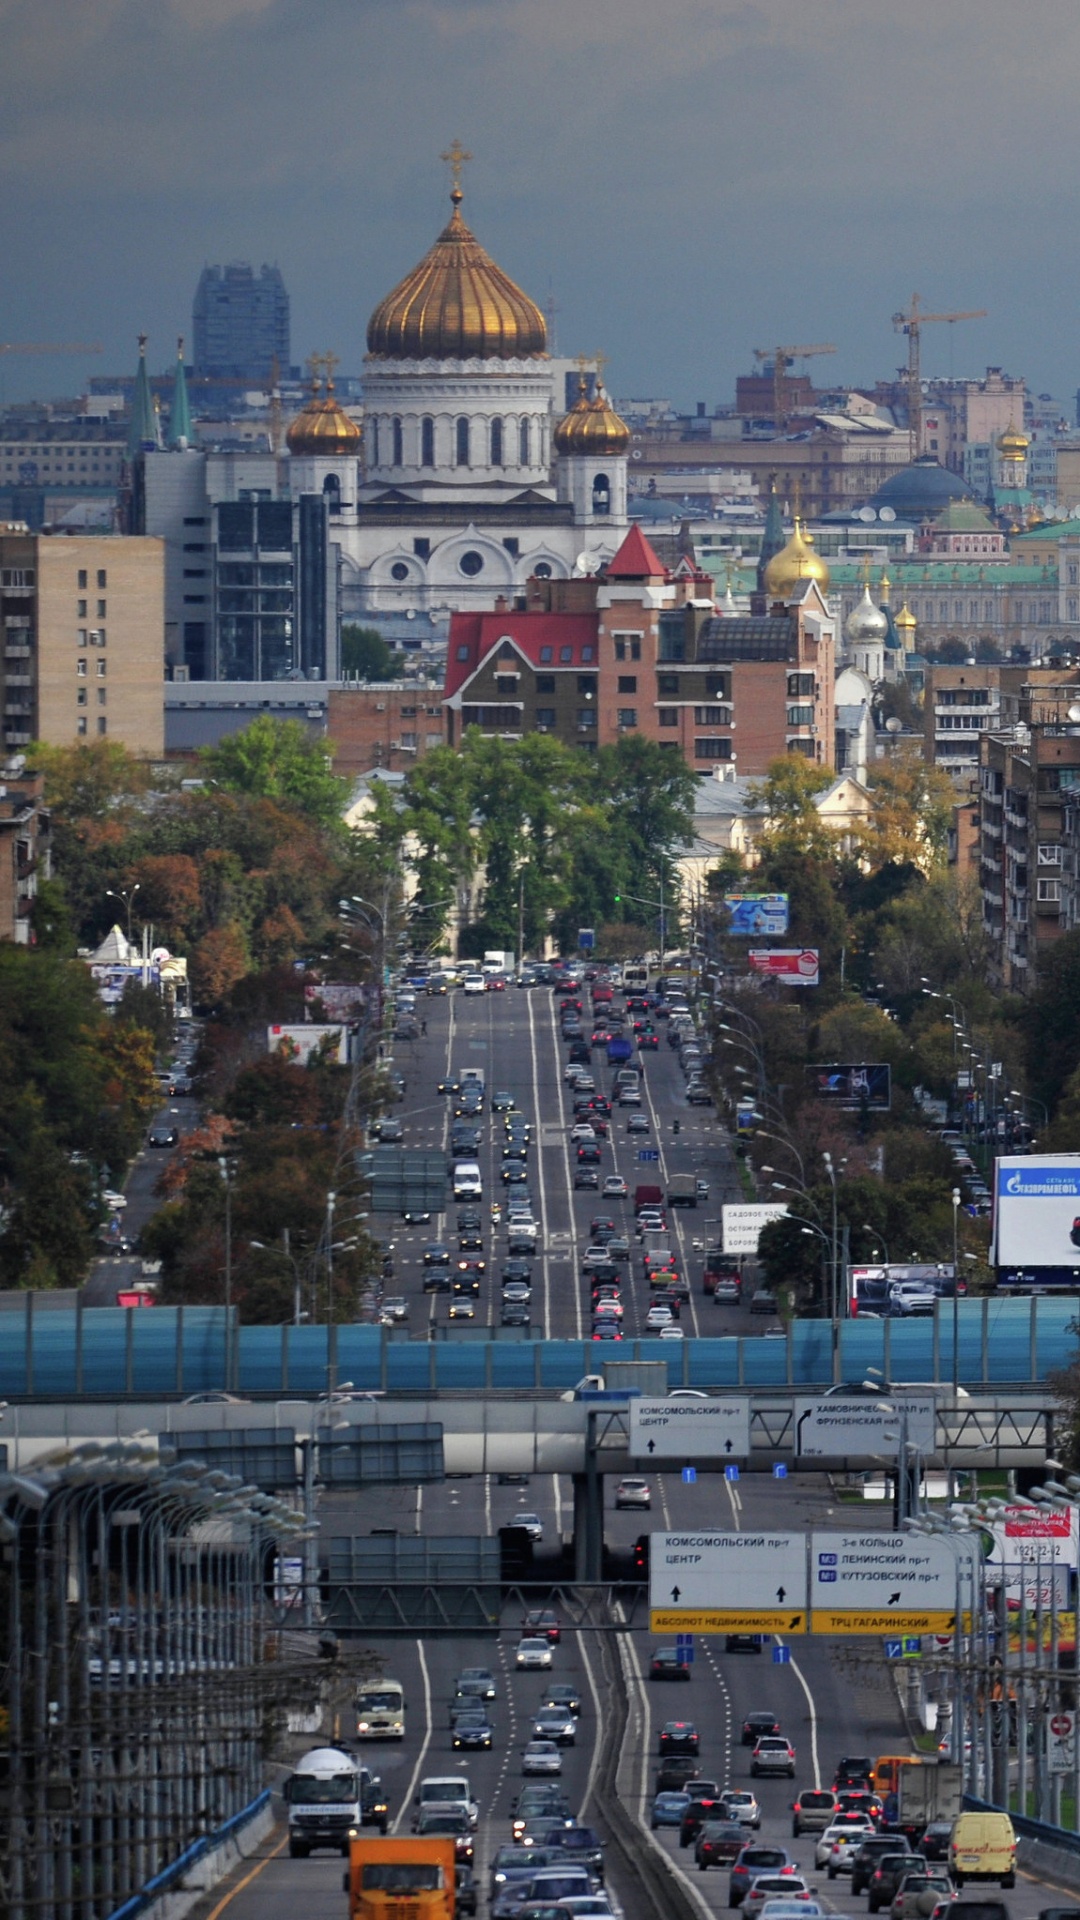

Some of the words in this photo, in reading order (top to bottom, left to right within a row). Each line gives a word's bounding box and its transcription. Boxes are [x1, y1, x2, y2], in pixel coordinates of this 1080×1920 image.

[639, 1406, 721, 1415] КОМСОМОЛЬСКИЙ
[722, 1408, 740, 1417] пр-т
[639, 1418, 669, 1427] ЦЕНТР
[816, 1417, 882, 1426] ФРУНЗЕНСКАЯ
[665, 1537, 765, 1547] КОМСОМОЛЬСКИЙ
[767, 1539, 790, 1549] пр-т
[841, 1538, 858, 1547] 3-е
[859, 1538, 904, 1549] КОЛЬЦО
[665, 1554, 702, 1564] ЦЕНТР
[841, 1554, 906, 1564] ЛЕНИНСКИЙ
[908, 1556, 931, 1566] пр-т
[841, 1570, 916, 1581] КУТУЗОВСКИЙ
[918, 1573, 941, 1583] пр-т
[655, 1617, 703, 1626] АБСОЛЮТ
[705, 1617, 785, 1627] НЕДВИЖИМОСТЬ
[831, 1617, 852, 1628] ТРЦ
[853, 1616, 929, 1627] ГАГАРИНСКИЙ
